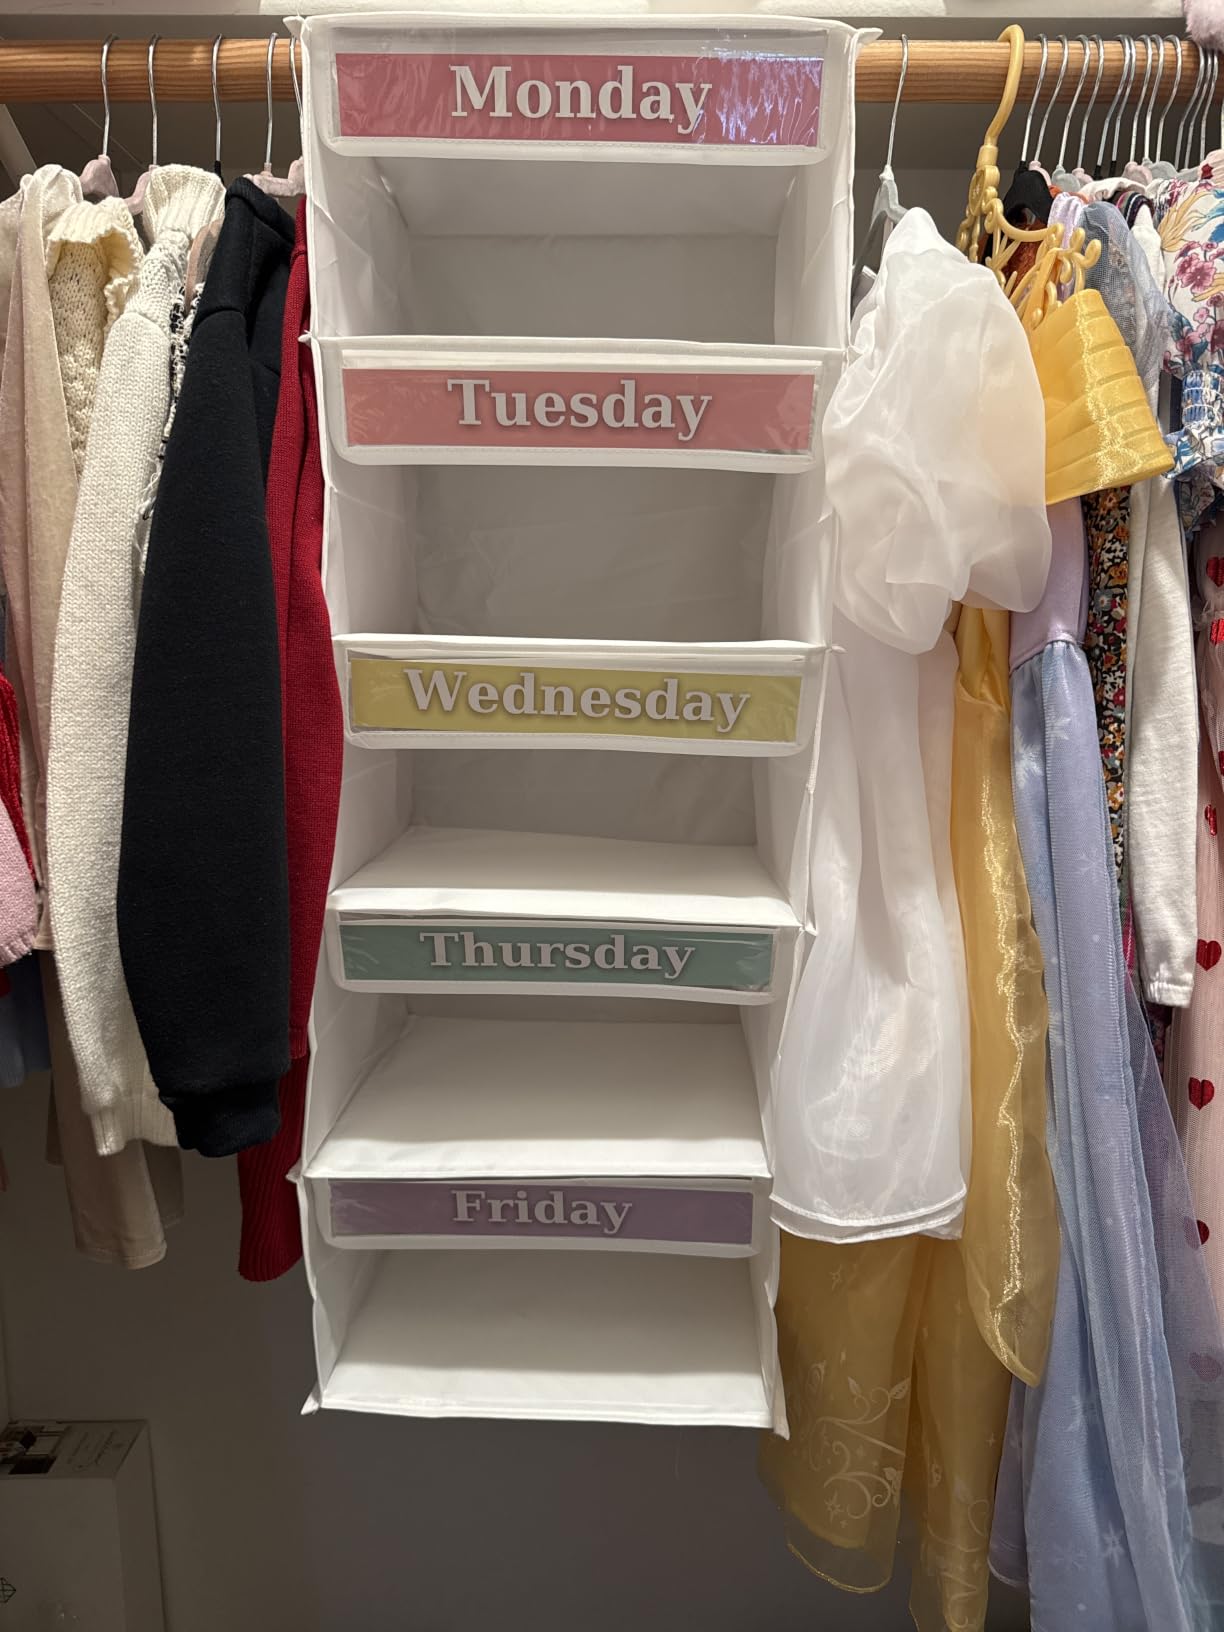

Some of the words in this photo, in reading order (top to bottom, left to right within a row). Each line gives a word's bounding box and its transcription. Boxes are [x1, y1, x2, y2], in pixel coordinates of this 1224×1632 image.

[450, 65, 713, 134] Monday
[447, 379, 713, 441] Tuesday
[403, 668, 750, 733] Wednesday
[419, 931, 696, 979] Thursday
[451, 1190, 633, 1234] Friday
